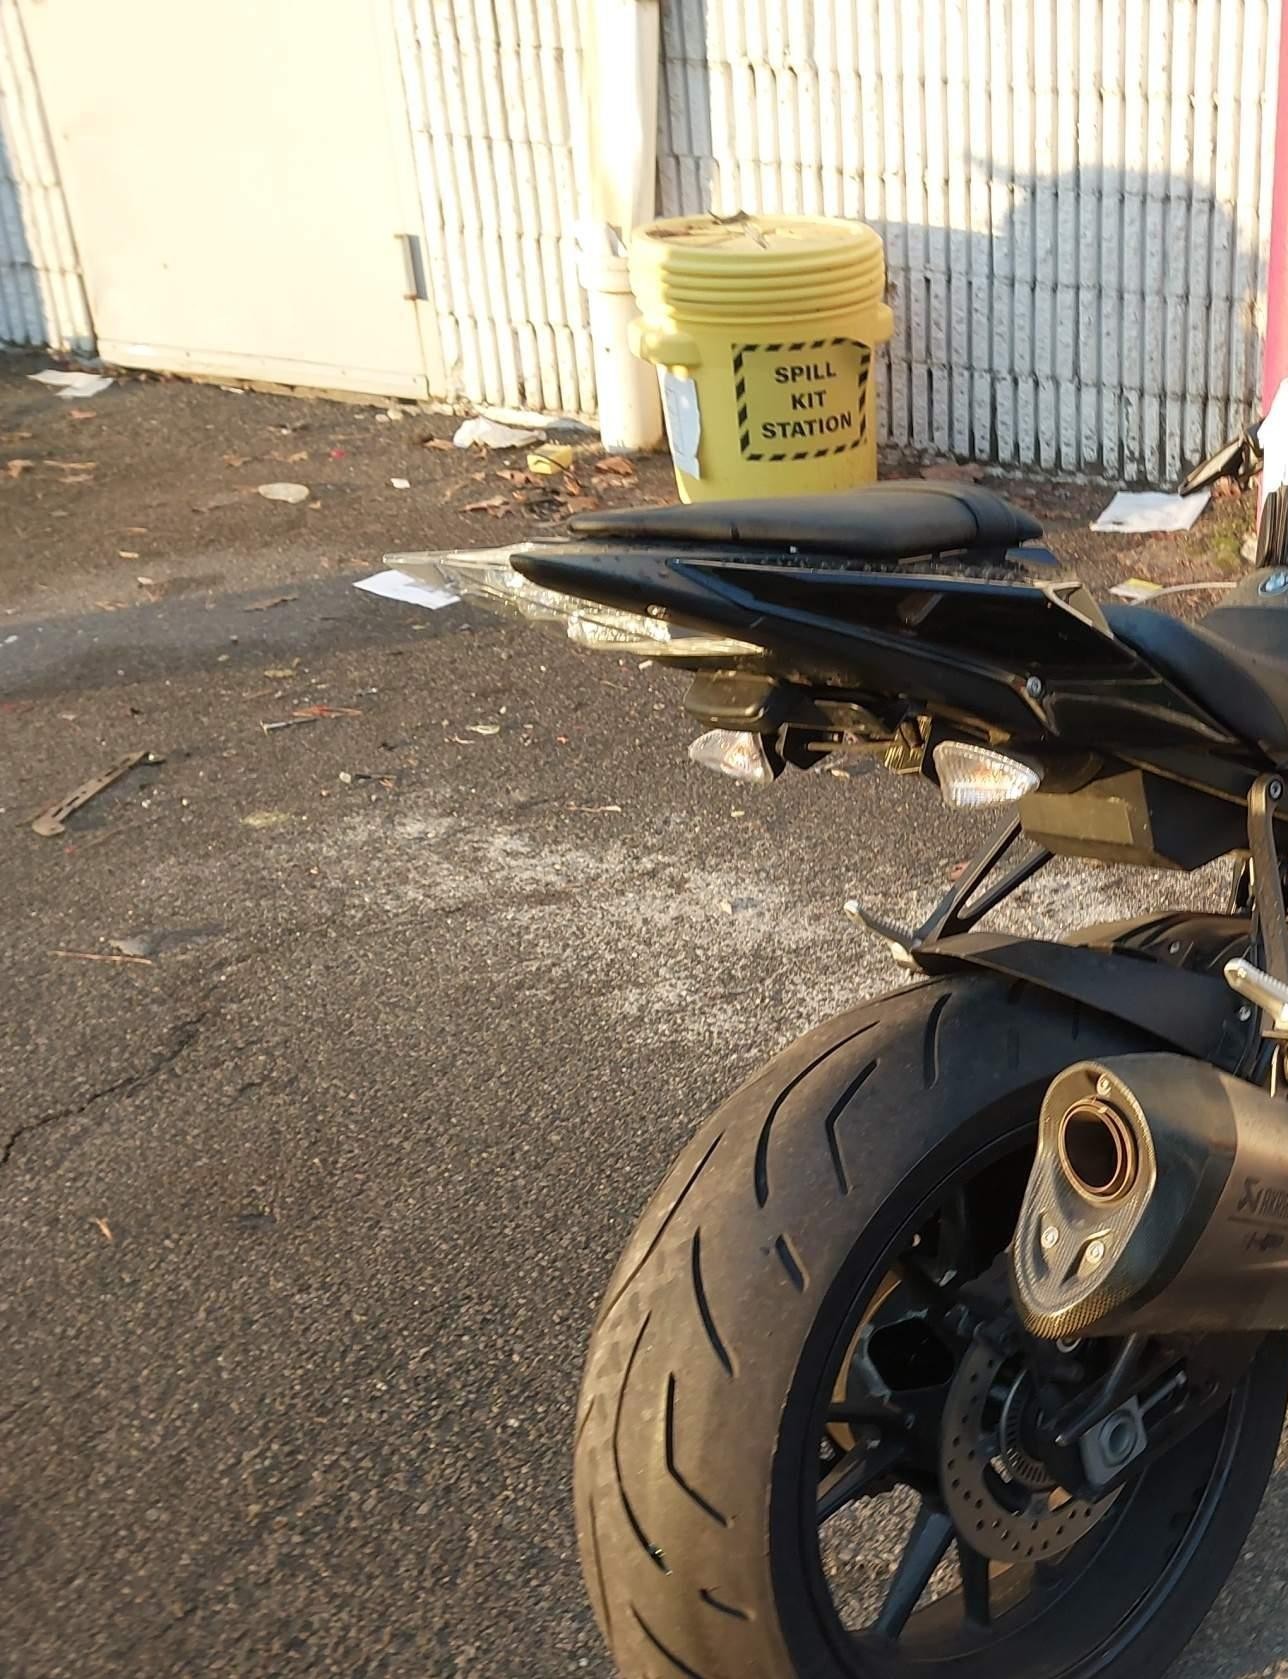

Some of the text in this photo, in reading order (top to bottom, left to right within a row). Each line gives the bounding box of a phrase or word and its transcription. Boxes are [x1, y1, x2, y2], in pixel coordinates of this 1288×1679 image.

[774, 362, 836, 383] SPILL
[791, 391, 827, 410] KIT
[761, 411, 852, 439] STATION
